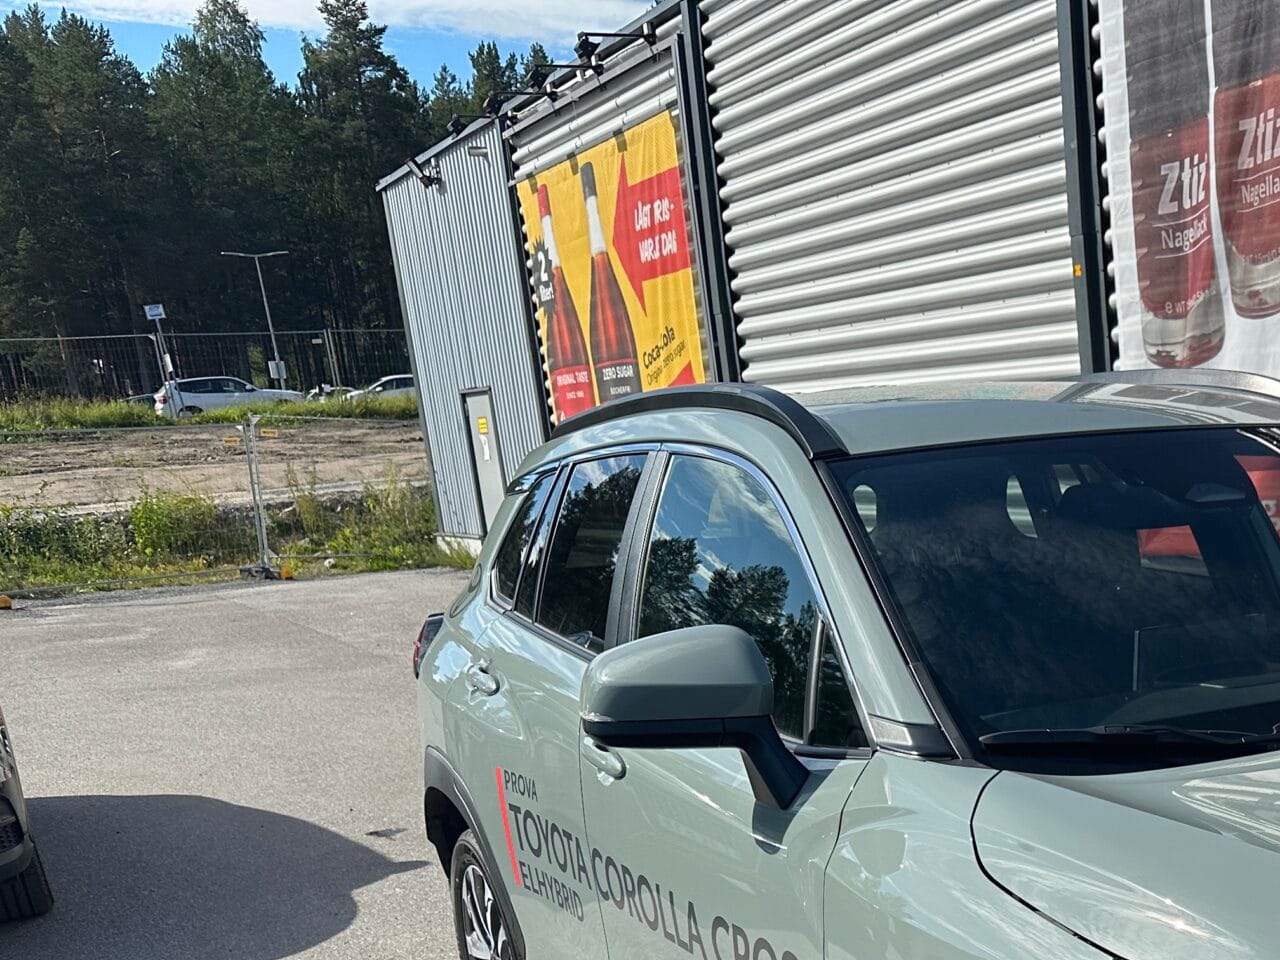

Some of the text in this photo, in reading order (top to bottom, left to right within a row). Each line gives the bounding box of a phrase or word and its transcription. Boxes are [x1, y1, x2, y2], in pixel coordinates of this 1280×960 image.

[1158, 153, 1207, 215] Ztiz
[1160, 213, 1208, 251] Nagellack
[537, 250, 549, 282] 2
[575, 371, 589, 383] TASTE
[602, 365, 634, 380] ZERO SUGAR
[503, 769, 538, 802] PROVA
[509, 802, 591, 890] TOYOTA
[519, 861, 584, 922] ELHYBRID
